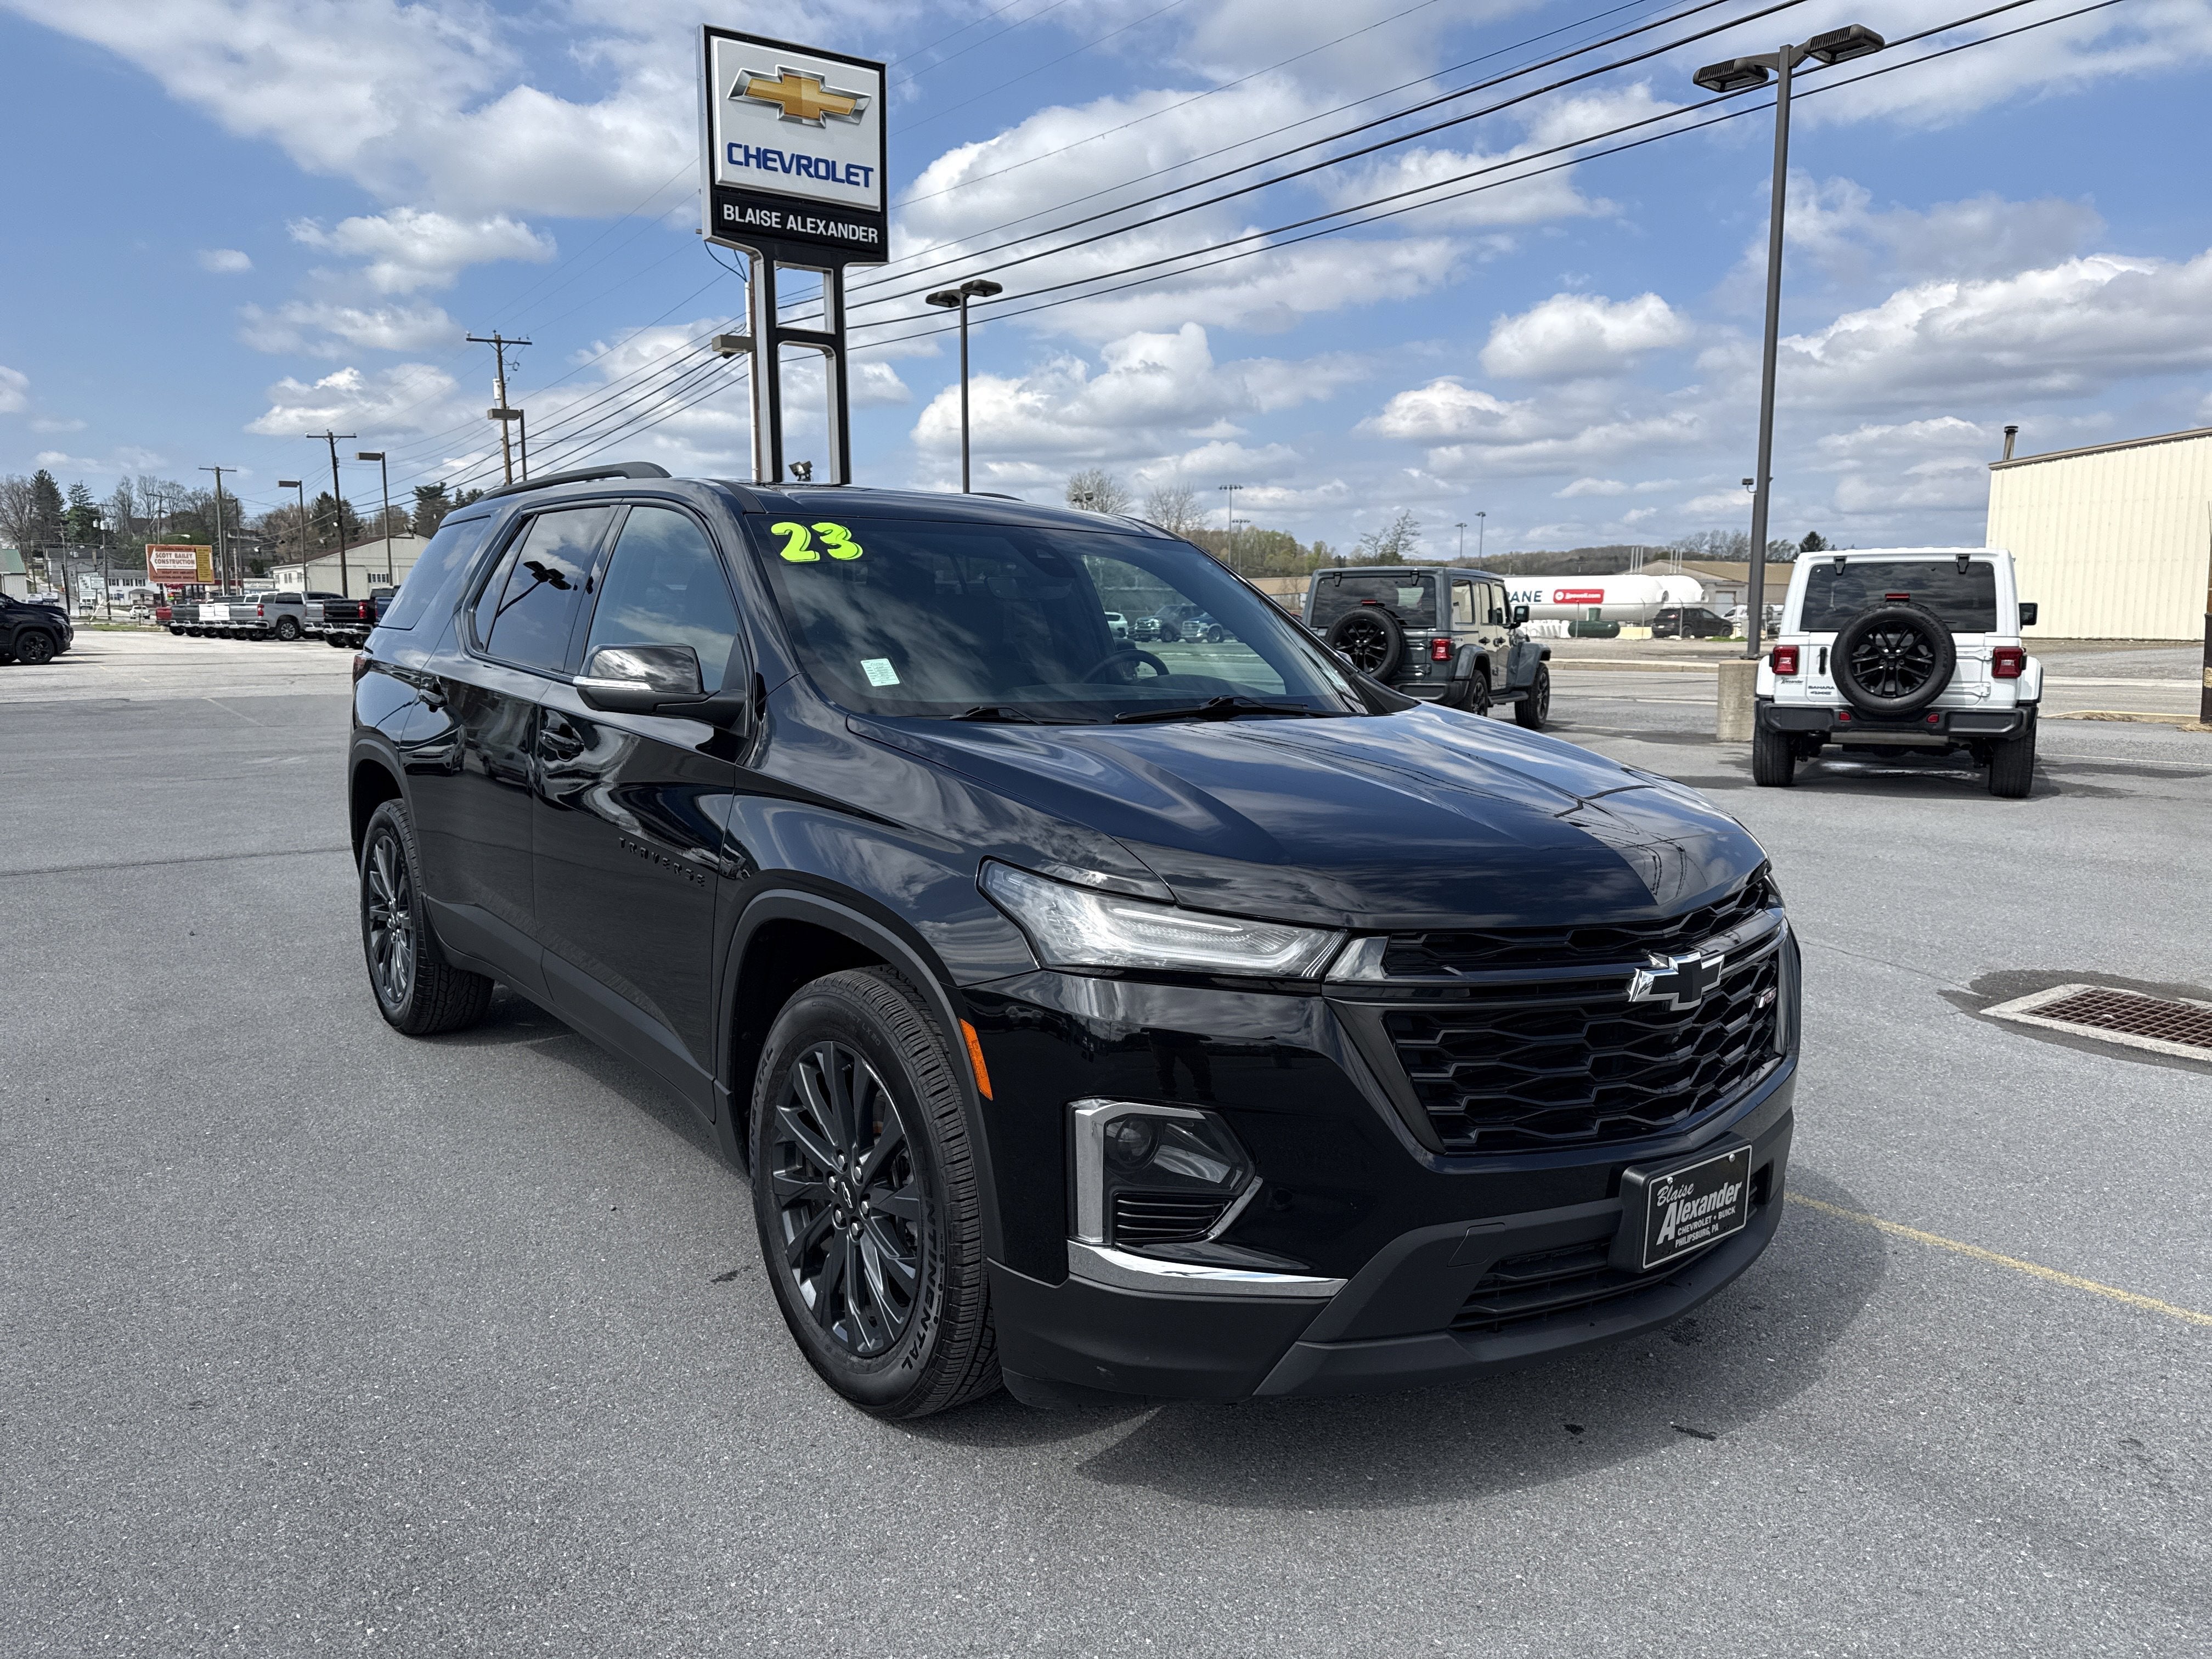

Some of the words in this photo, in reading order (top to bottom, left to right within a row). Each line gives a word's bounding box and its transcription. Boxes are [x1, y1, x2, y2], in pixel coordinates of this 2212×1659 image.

[727, 142, 874, 188] CHEVROLET
[723, 204, 781, 228] BLAISE
[786, 215, 878, 243] ALEXANDER
[771, 522, 863, 562] 23
[1507, 590, 1543, 603] ANE
[1657, 1183, 1694, 1206] Blaise
[1656, 1181, 1742, 1246] Alexander
[1677, 1215, 1712, 1236] CHEVROLET
[1718, 1206, 1736, 1220] BUICK
[1675, 1227, 1711, 1248] PHILIPSBURG,
[1712, 1223, 1719, 1233] PA
